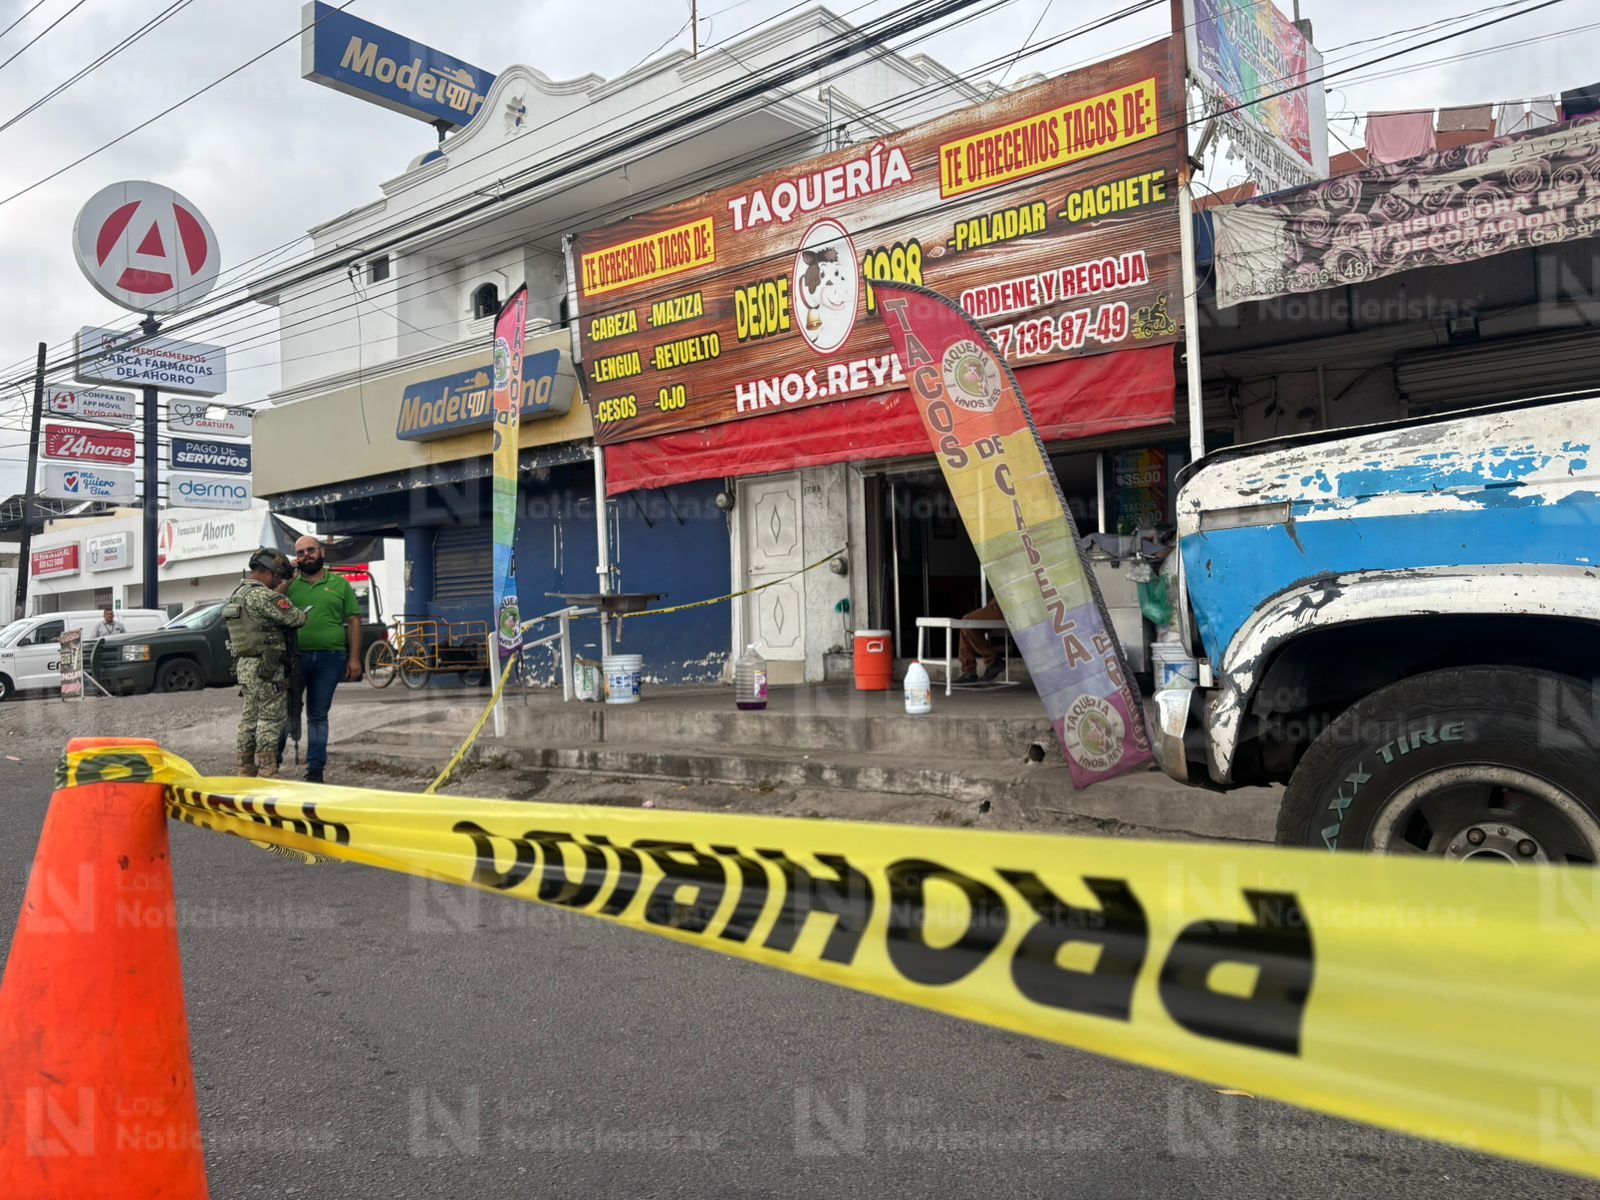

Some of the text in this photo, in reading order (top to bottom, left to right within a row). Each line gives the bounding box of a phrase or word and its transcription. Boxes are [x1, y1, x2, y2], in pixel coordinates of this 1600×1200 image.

[340, 35, 485, 116] Modelor
[944, 88, 1152, 189] TE OFRECEMOS TACOS DE:
[728, 142, 913, 232] TAQUERÍA
[948, 170, 1166, 253] -PALADAR -CACHETE
[585, 224, 712, 291] TE OFRECEMOS TACOS DE:
[1343, 259, 1374, 278] 481
[734, 276, 791, 341] DESDE
[962, 254, 1147, 320] ORDENE Y RECOJA
[587, 292, 703, 342] -CABEZA -MAZIZA
[1016, 303, 1129, 359] 136-87-49
[99, 350, 213, 376] ARCA FARMACIAS
[117, 367, 195, 385] DEL AHORRO
[590, 333, 721, 383] -LENGUA -REVUELTO
[83, 391, 115, 401] COMPRA
[398, 375, 553, 433] Modelorma
[735, 352, 908, 413] HNOS.REYE
[883, 298, 969, 470] TACOS
[98, 401, 122, 410] MÓVIL
[195, 420, 235, 430] GRATUITA
[595, 385, 687, 424] -CESOS -OJO
[177, 451, 248, 467] SERVICIOS
[186, 442, 237, 456] PAGO DE
[80, 471, 96, 479] me
[89, 486, 112, 496] Bien
[178, 480, 247, 499] derma
[202, 521, 235, 541] Ahorro
[1375, 721, 1466, 764] TIRE
